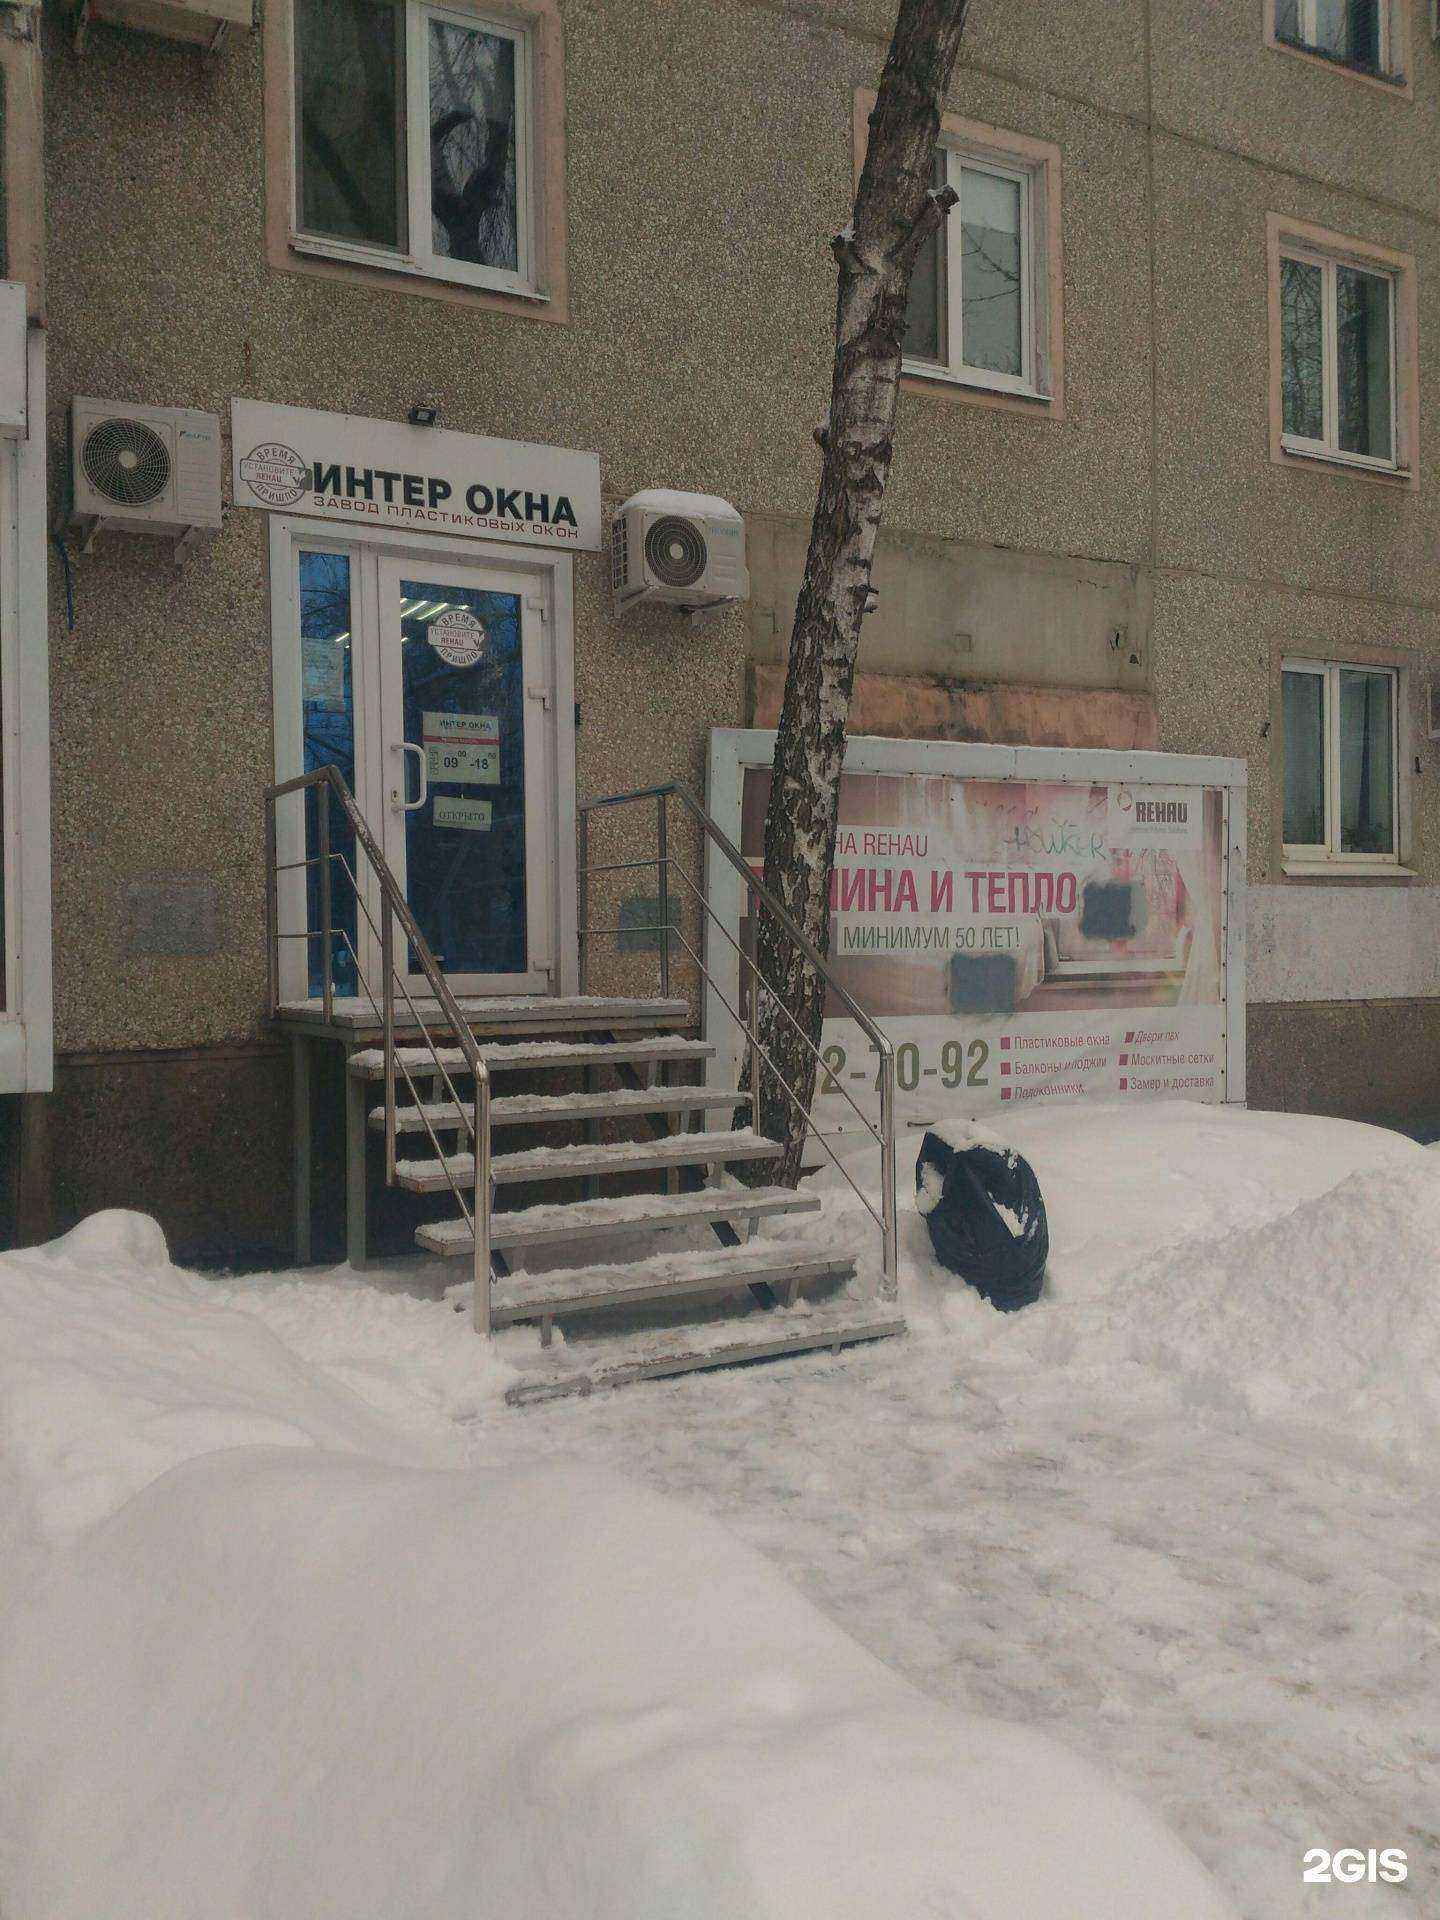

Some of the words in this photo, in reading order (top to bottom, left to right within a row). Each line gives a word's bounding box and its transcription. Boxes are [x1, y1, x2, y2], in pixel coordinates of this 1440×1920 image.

[256, 447, 296, 465] ВРЕМЯ
[255, 484, 298, 502] ПРИШЛО
[313, 462, 452, 508] ИНТЕР
[465, 484, 578, 527] ОКНА
[313, 496, 379, 515] ЗАВОД
[387, 505, 525, 532] ПЛАСТИКОВЫХ
[532, 524, 578, 538] ОКОН
[441, 613, 476, 628] ВРЕМЯ
[439, 810, 485, 821] ОТКРЫТО
[1135, 801, 1189, 823] REHAU
[835, 832, 858, 854] НА
[864, 833, 928, 856] REHAU
[931, 869, 953, 912] И
[965, 871, 1077, 914] ТЕПЛО
[843, 926, 950, 950] МИНИМУМ
[956, 926, 976, 949] 50
[980, 926, 1021, 949] ЛЕТ!
[1014, 1036, 1083, 1049] Пластиковые
[1086, 1035, 1110, 1046] окна
[1135, 1030, 1162, 1044] Двери
[1014, 1061, 1062, 1075] Балконы
[1071, 1055, 1107, 1071] лоджии
[1130, 1053, 1185, 1066] Москитные
[1188, 1053, 1216, 1064] сетки
[1014, 1082, 1085, 1100] Подоконники
[1130, 1077, 1160, 1091] Замер
[1171, 1076, 1215, 1089] доставка
